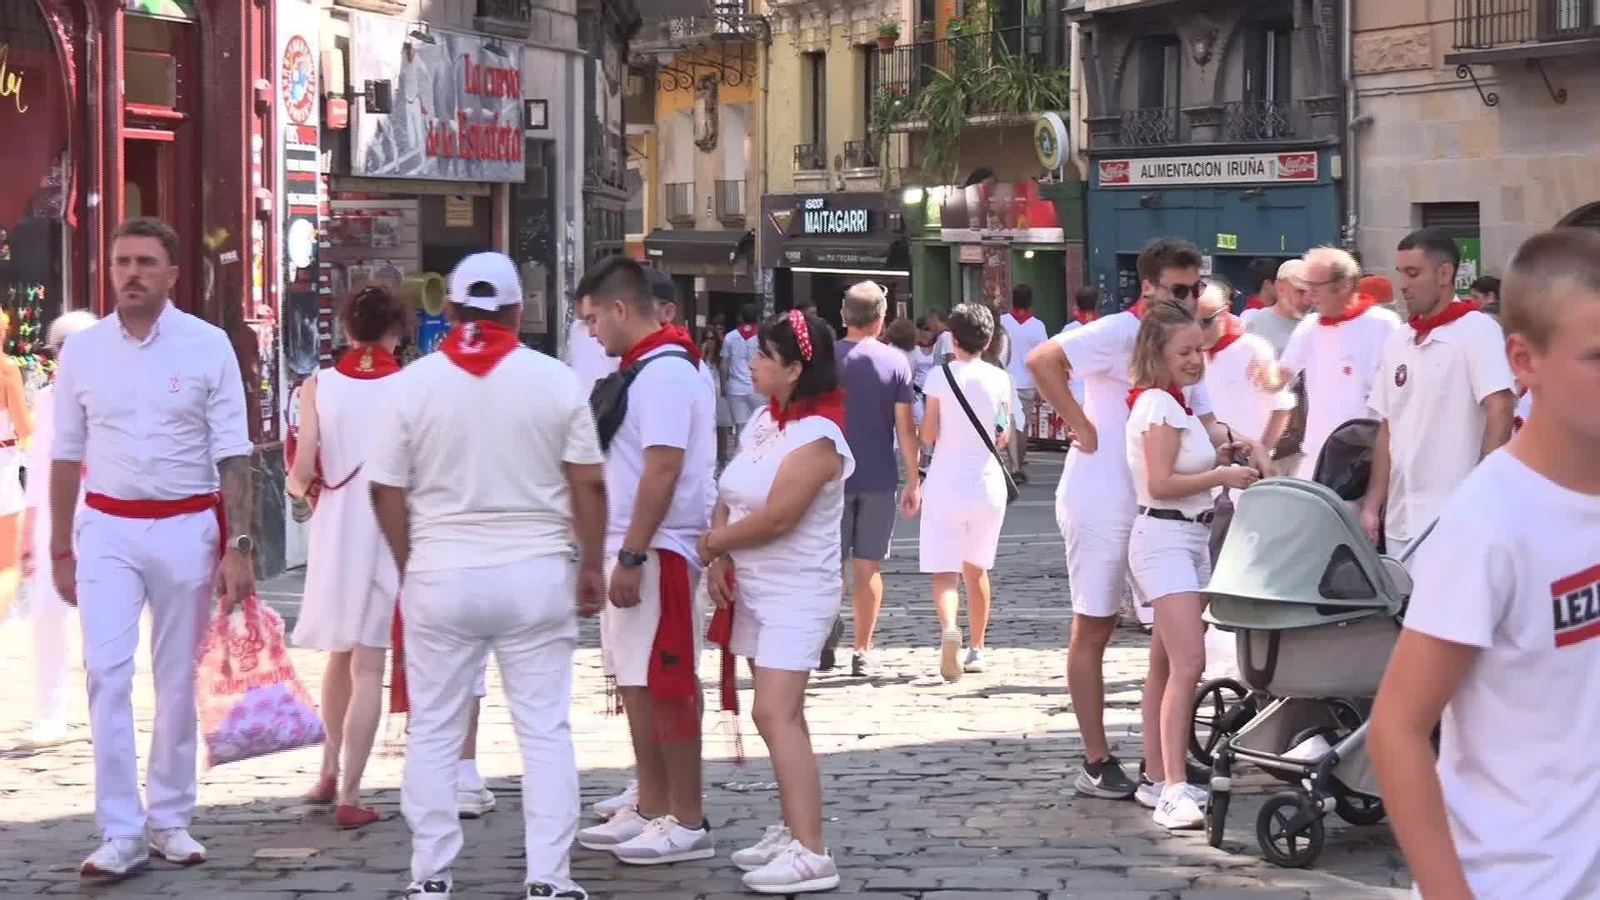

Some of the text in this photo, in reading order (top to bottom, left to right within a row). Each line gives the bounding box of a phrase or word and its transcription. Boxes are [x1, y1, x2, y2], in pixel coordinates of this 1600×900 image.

[464, 53, 481, 94] La
[1140, 157, 1265, 179] ALIMENTACION IRUÑA
[805, 209, 868, 233] MAITAGARRI
[1553, 582, 1600, 630] LEZ
